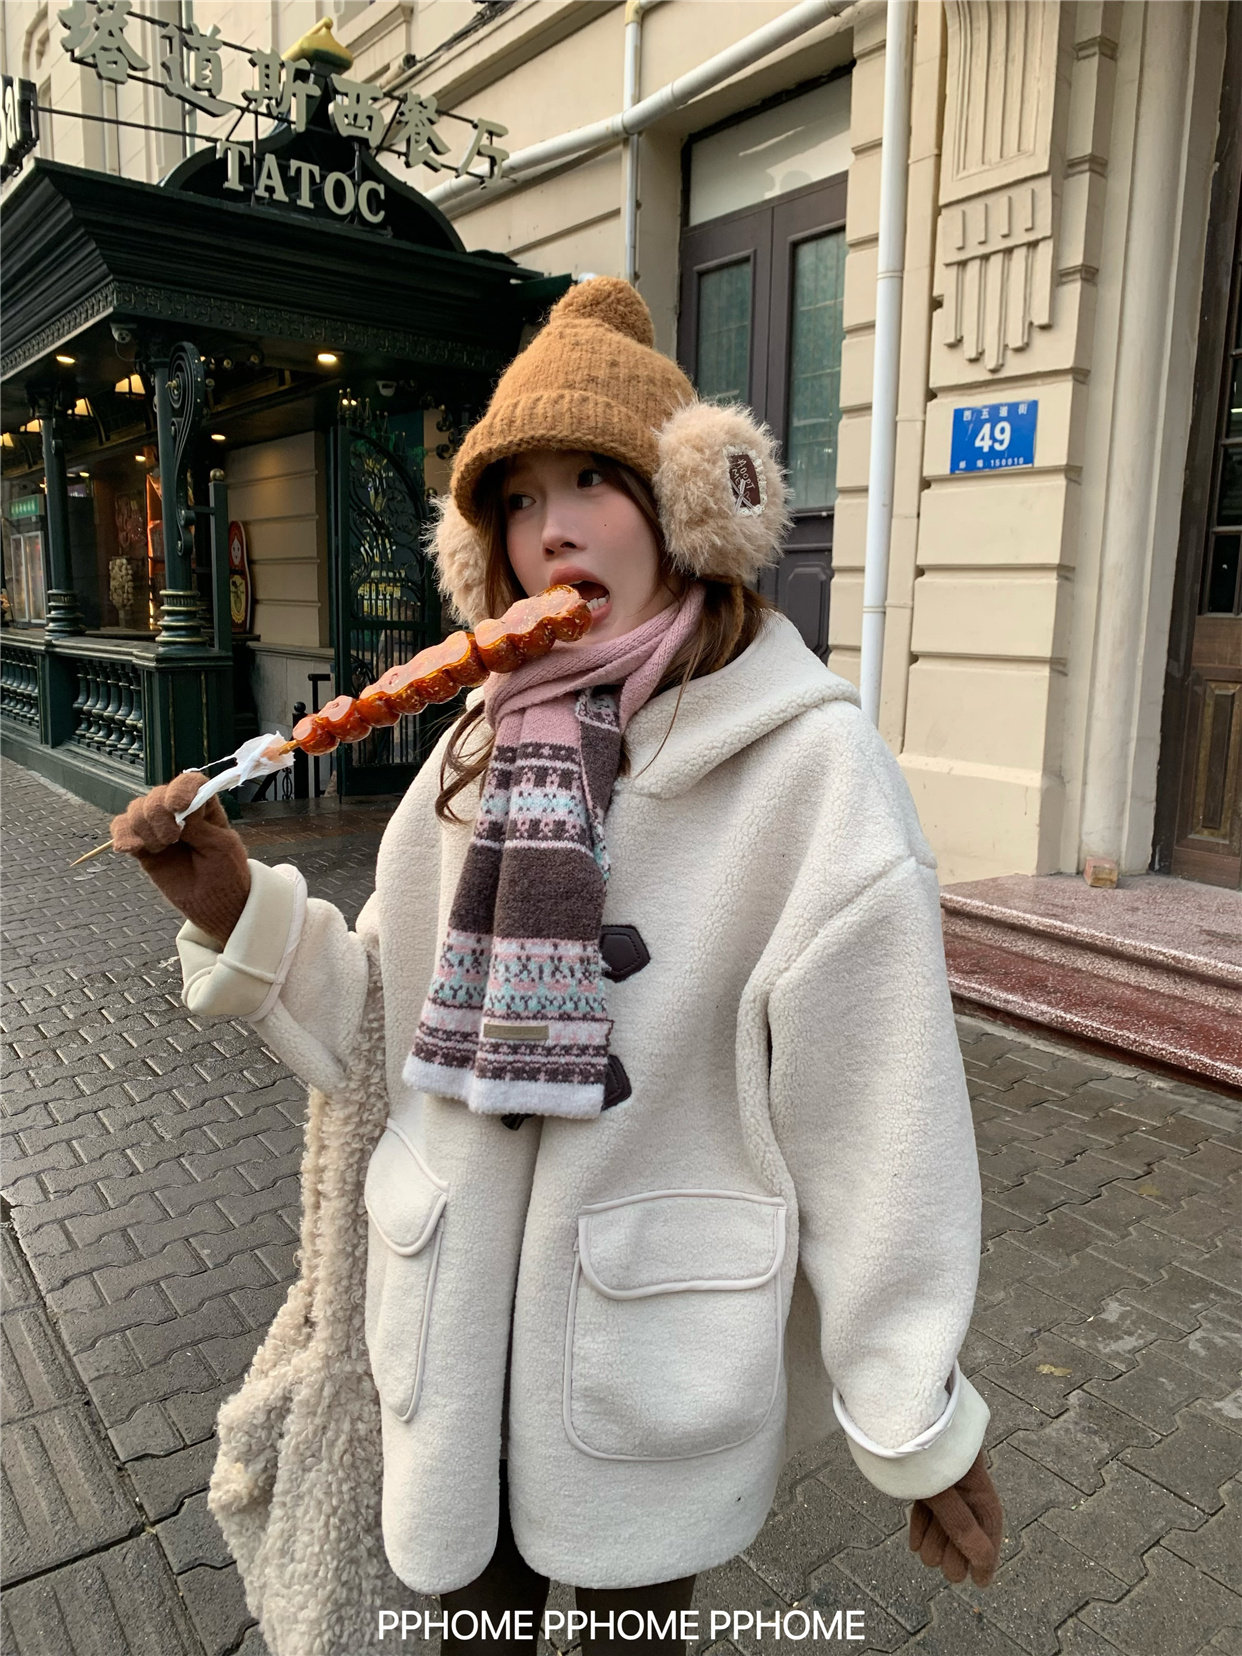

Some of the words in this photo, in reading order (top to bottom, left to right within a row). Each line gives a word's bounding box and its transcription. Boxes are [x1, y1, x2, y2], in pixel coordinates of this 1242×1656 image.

[57, 0, 510, 187] 塔道斯西餐厅
[216, 140, 387, 224] TATOC
[974, 420, 1012, 453] 49
